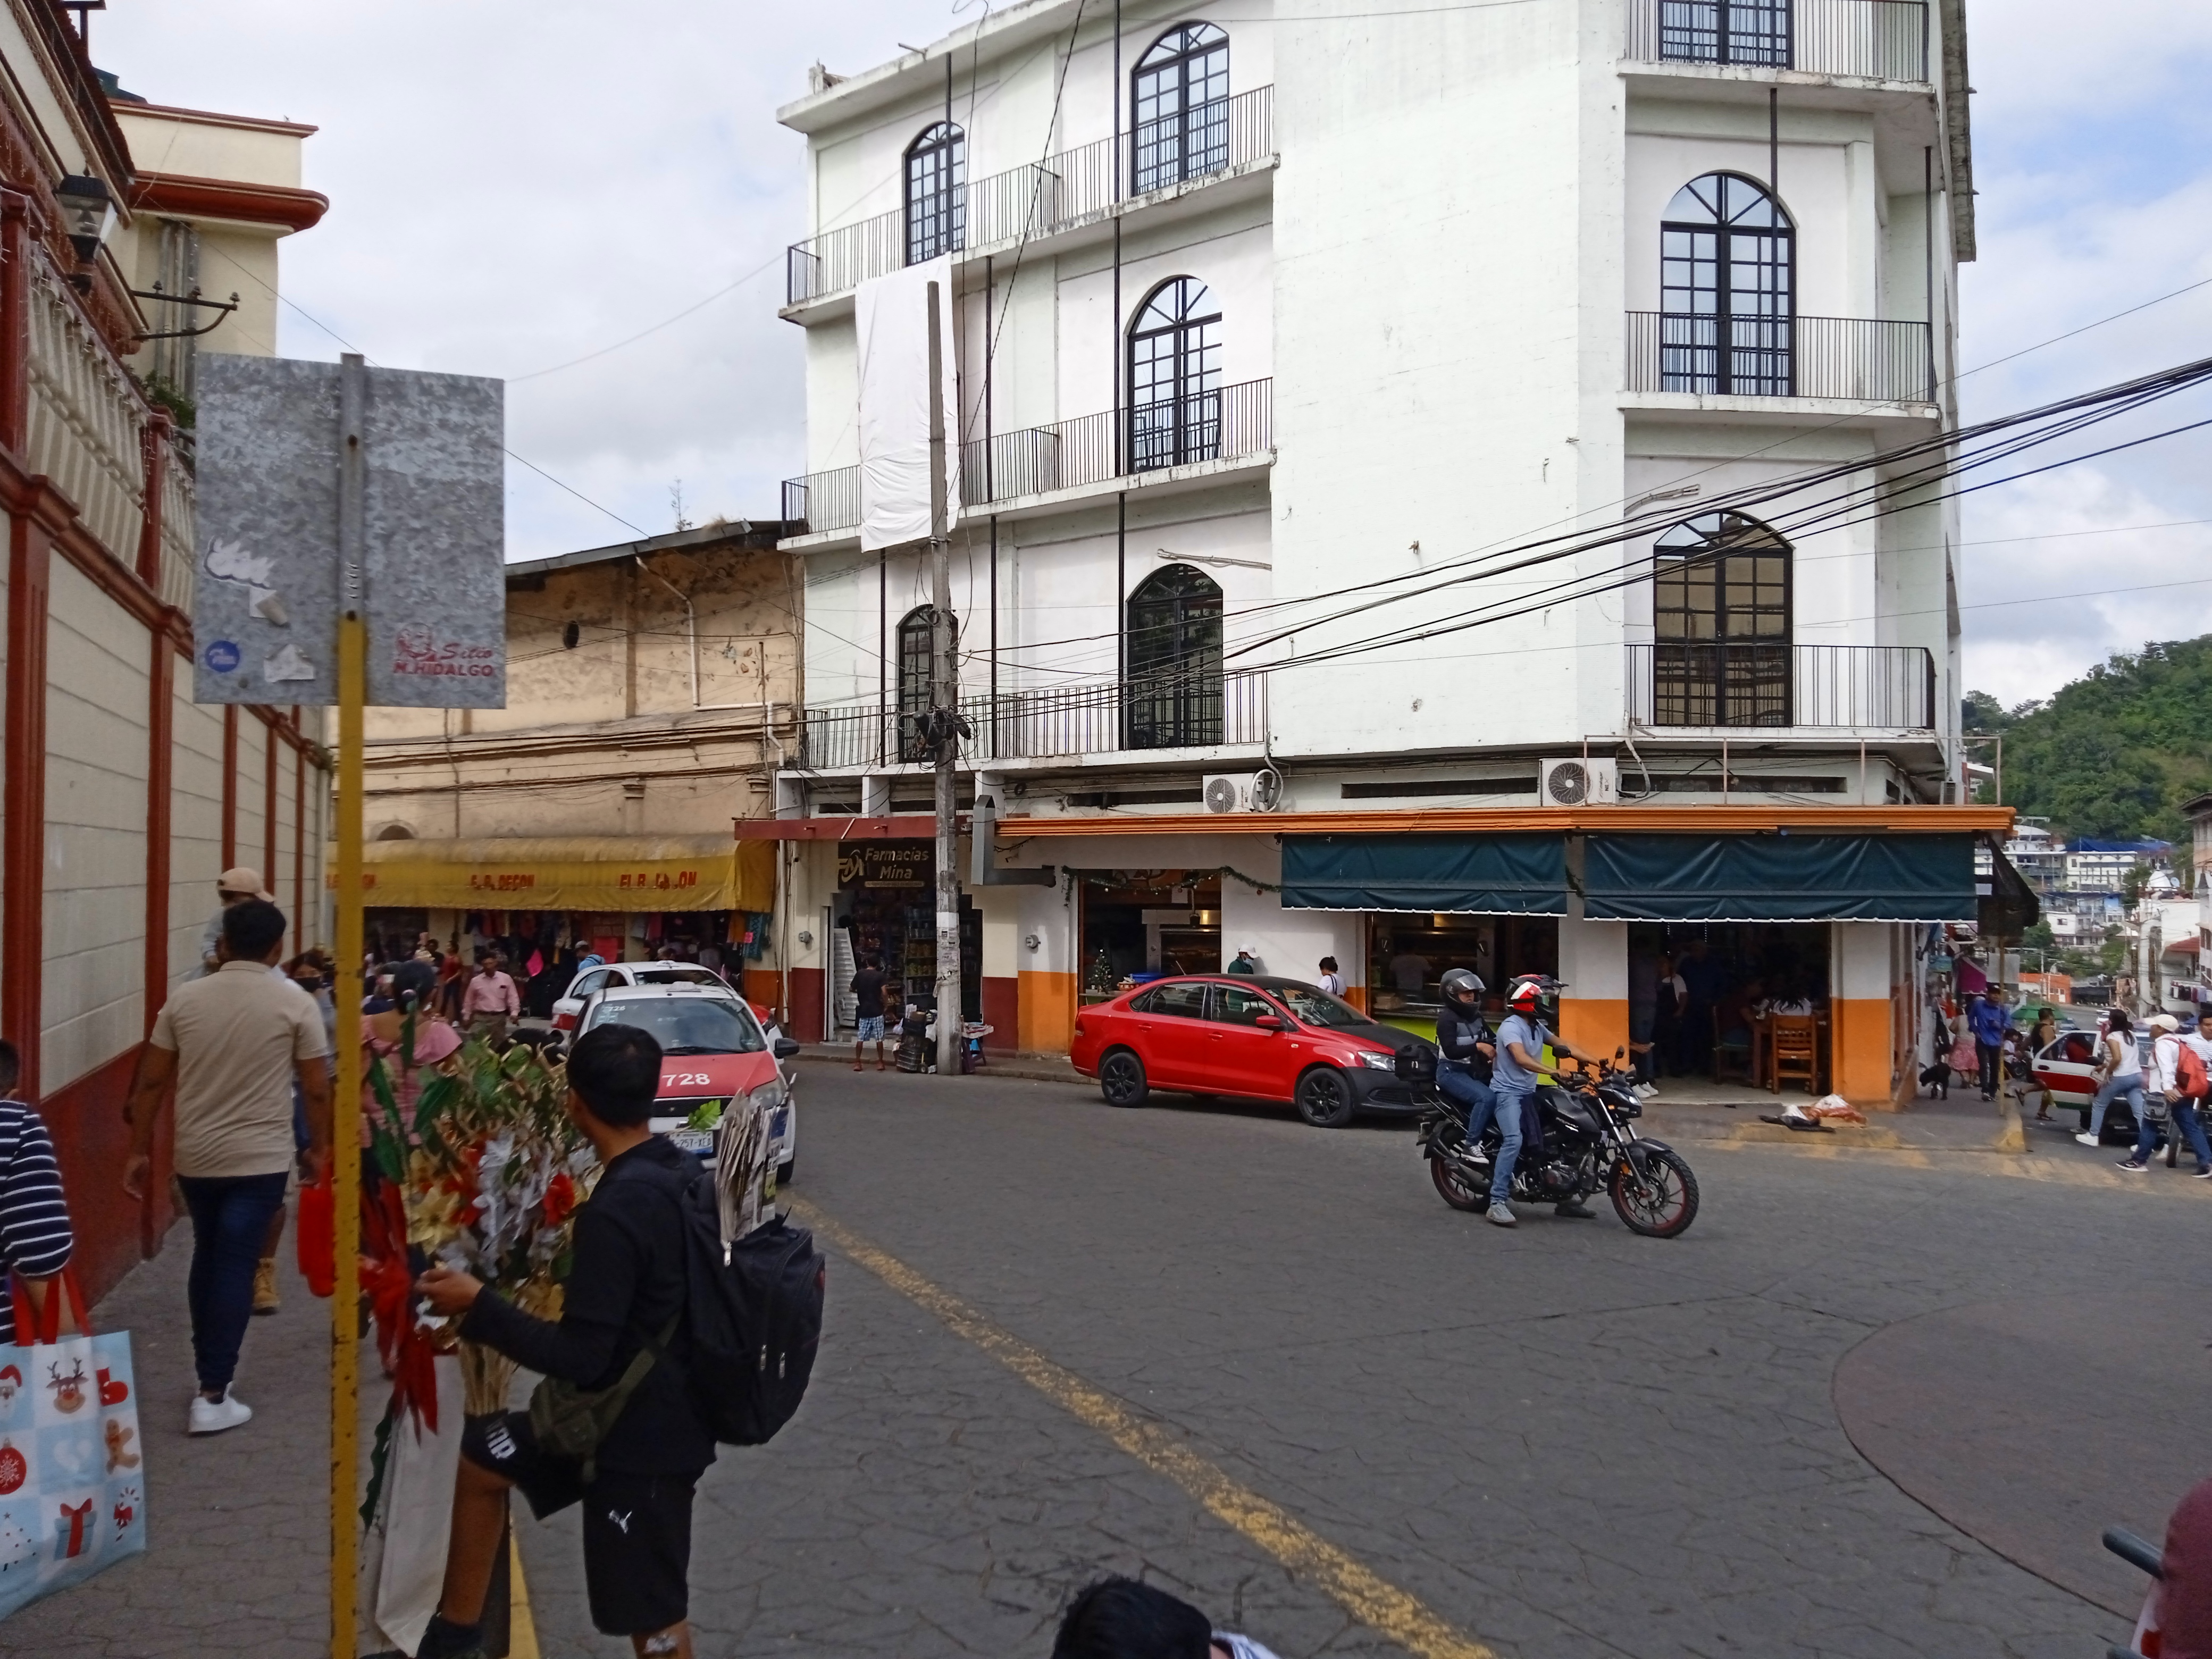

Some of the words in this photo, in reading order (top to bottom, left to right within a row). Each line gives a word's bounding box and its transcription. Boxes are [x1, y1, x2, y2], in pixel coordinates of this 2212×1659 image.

[865, 847, 929, 861] Farmacias
[879, 865, 912, 879] Mina
[661, 1073, 711, 1087] 728
